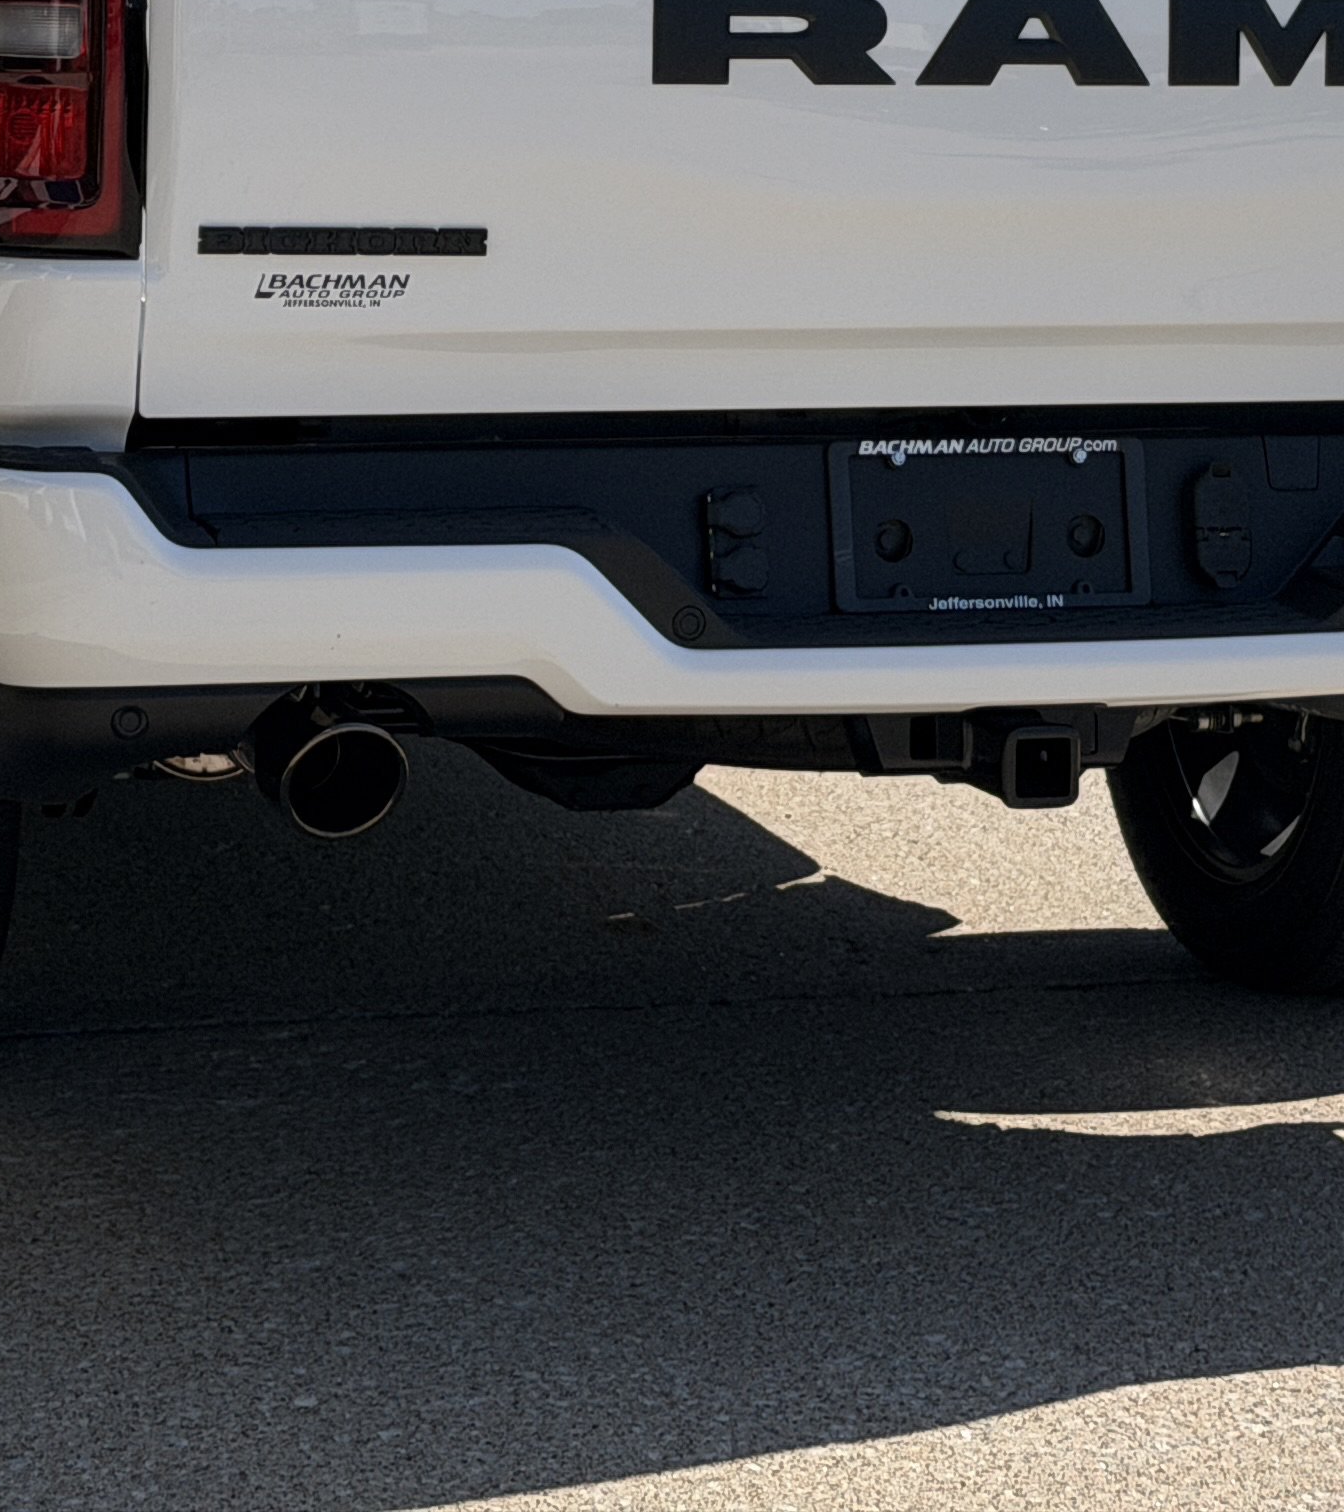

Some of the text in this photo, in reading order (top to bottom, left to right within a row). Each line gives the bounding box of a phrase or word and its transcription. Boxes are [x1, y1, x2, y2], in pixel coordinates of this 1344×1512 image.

[267, 273, 411, 290] BACHMAN
[278, 289, 406, 299] AUTO GROUP
[282, 299, 381, 309] JEFFERSONVILLE, IN
[858, 437, 1118, 456] BACHMAN AUTO GROUPcom
[928, 593, 1064, 610] Jeffersonville, IN
